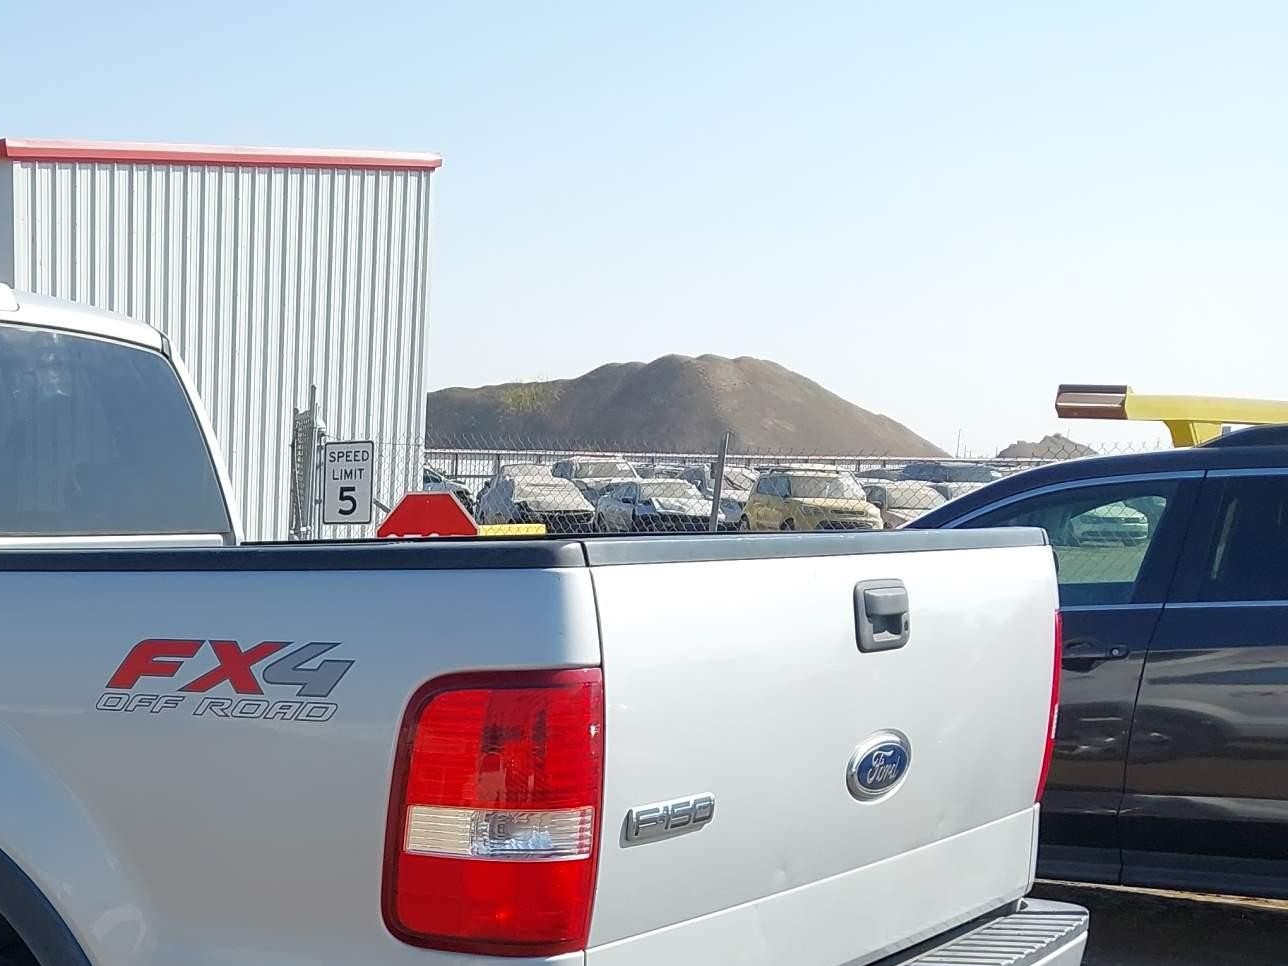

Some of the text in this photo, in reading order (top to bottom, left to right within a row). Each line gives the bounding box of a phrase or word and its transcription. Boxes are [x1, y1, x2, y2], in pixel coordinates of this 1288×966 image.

[329, 450, 370, 462] SPEED
[332, 468, 364, 480] LIMIT
[338, 486, 357, 515] 5
[105, 639, 355, 698] FX4
[96, 692, 338, 722] OFF ROAD
[866, 749, 901, 784] Ford
